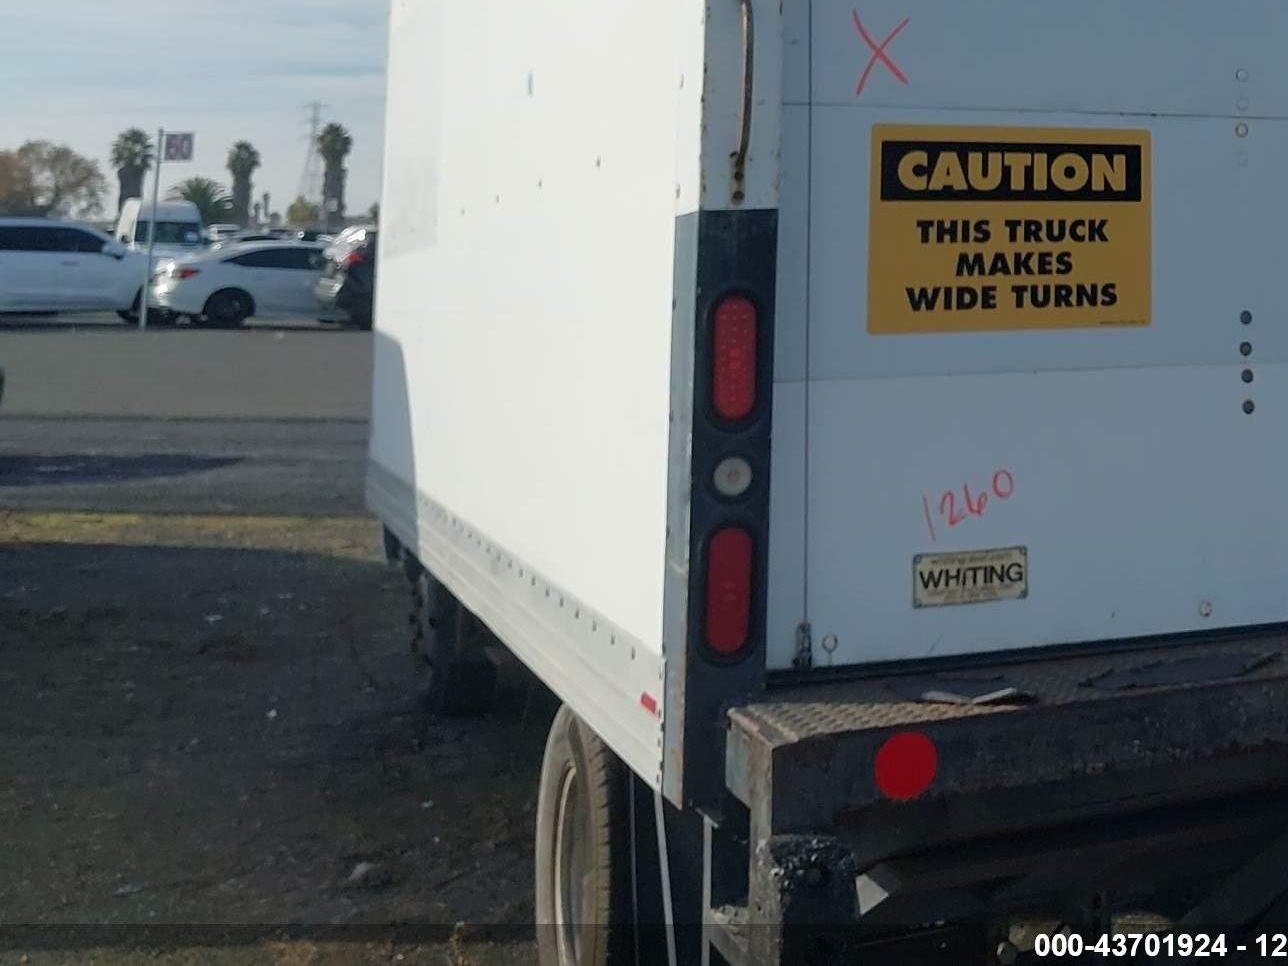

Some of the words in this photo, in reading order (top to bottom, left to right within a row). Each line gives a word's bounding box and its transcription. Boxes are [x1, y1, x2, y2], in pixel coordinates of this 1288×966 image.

[898, 150, 1126, 192] CAUTION
[916, 219, 992, 244] THIS
[1004, 219, 1110, 243] TRUCK
[955, 251, 1074, 277] MAKES
[905, 286, 998, 312] WIDE
[1011, 283, 1118, 309] TURNS
[922, 468, 1015, 543] 1260
[919, 562, 1024, 590] WHITING
